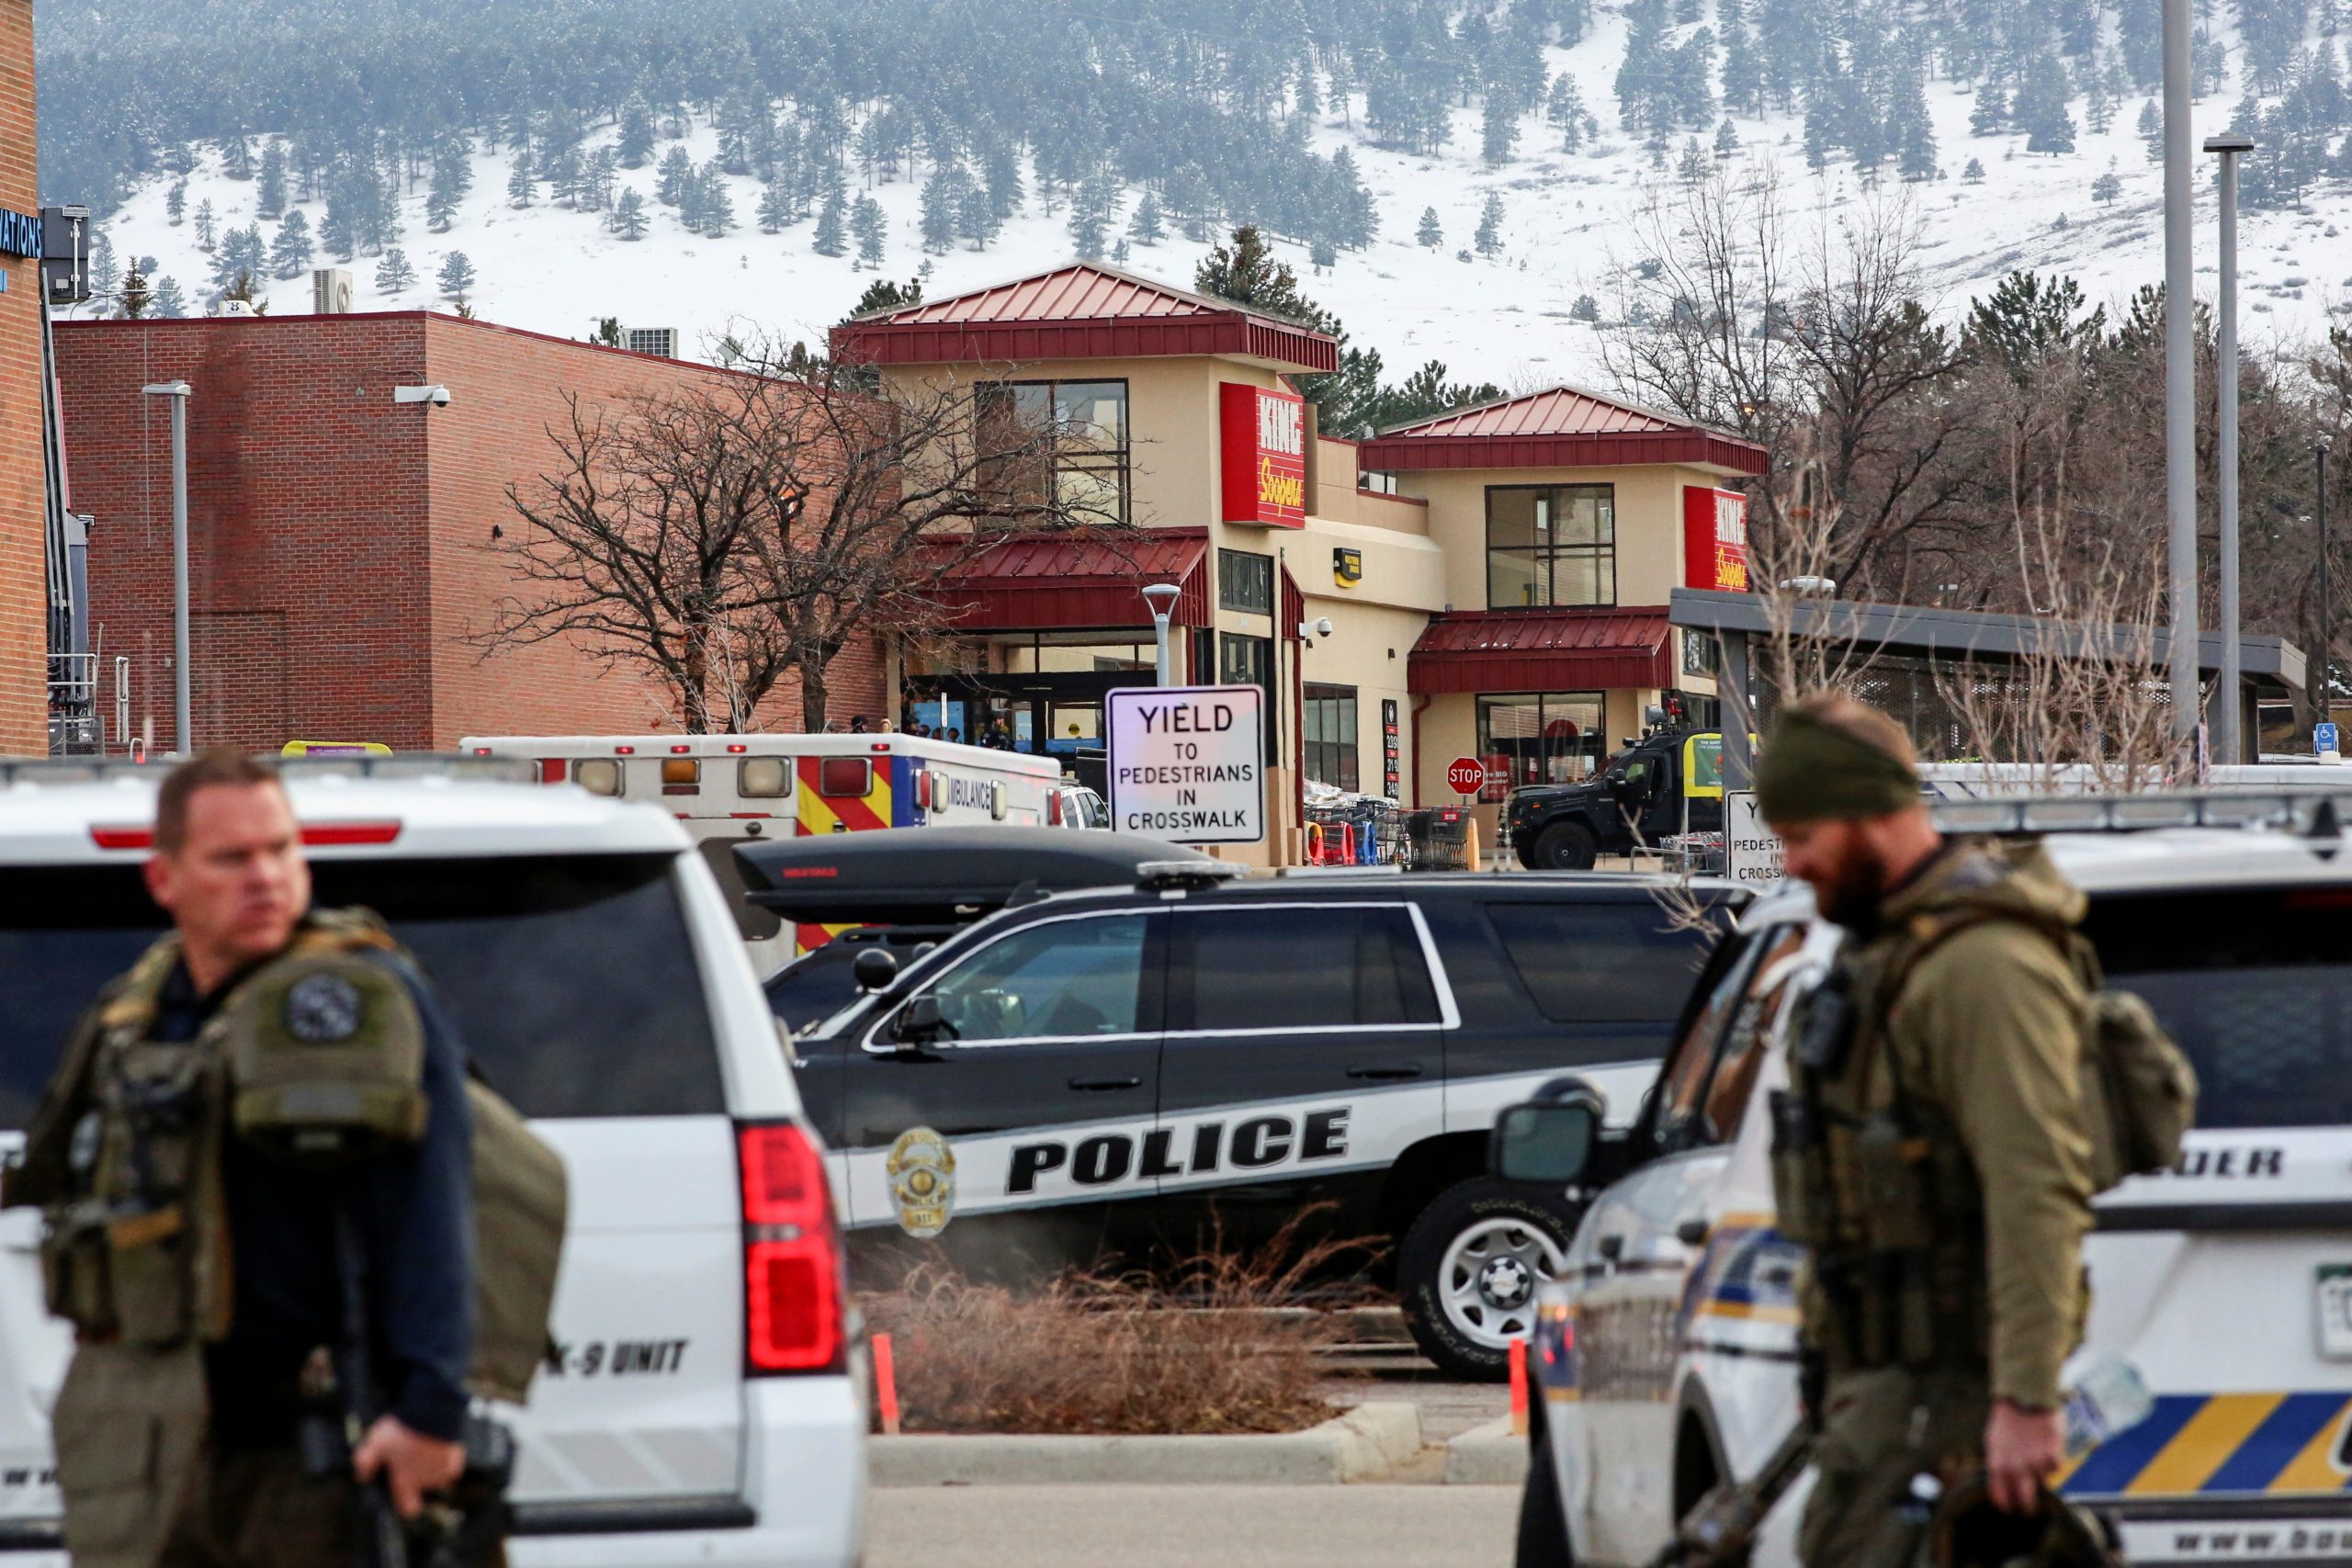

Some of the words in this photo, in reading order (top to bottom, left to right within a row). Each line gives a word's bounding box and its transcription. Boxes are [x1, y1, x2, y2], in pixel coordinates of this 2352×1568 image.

[0, 208, 42, 261] ATIONS
[1261, 396, 1301, 456] KING
[1716, 496, 1745, 546] KING
[1137, 705, 1233, 734] YIELD
[1173, 742, 1198, 760] TO
[1119, 764, 1253, 784] PEDESTRIANS
[1449, 768, 1482, 784] STOP
[947, 777, 990, 810] MBULANCE
[1177, 789, 1196, 806] IN
[1128, 810, 1247, 830] CROSSWALK
[1734, 838, 1782, 851] PEDEST
[1005, 1106, 1351, 1196] POLICE
[2170, 1149, 2283, 1178] DER
[609, 1338, 687, 1375] UNIT
